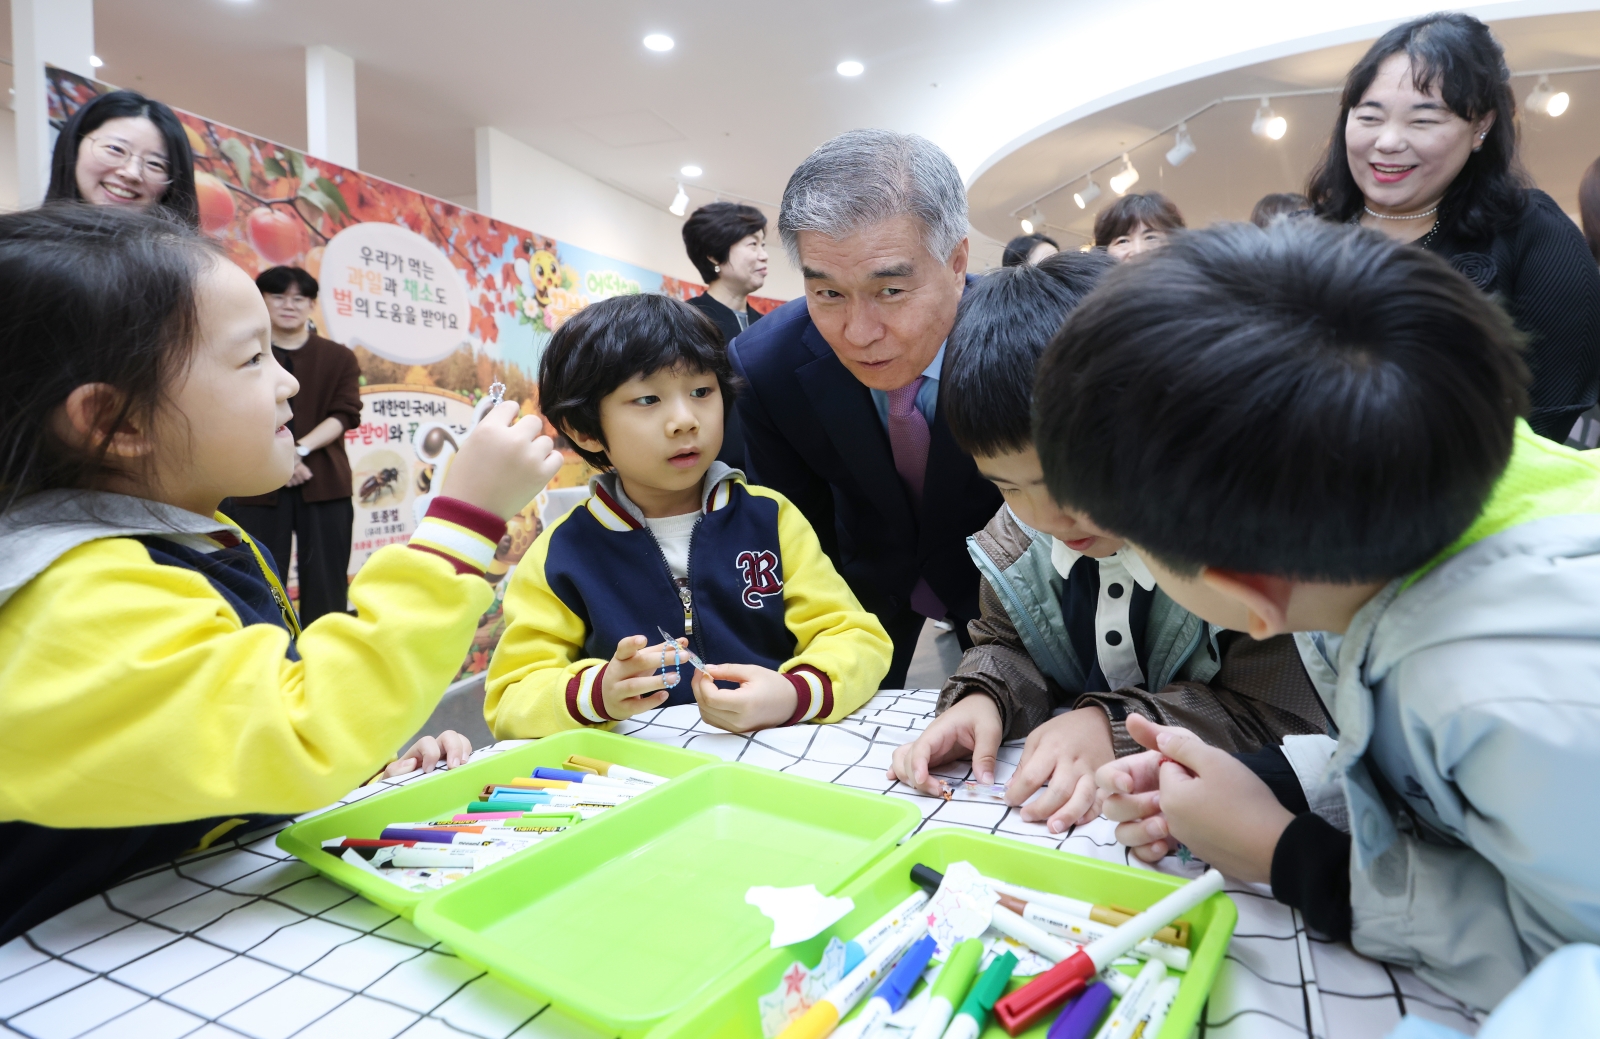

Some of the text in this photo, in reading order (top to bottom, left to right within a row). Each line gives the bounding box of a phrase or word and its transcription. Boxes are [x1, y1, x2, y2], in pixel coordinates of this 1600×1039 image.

[360, 246, 434, 281] 우리가 먹는
[347, 266, 447, 304] 과일과 채소도
[333, 288, 458, 329] 벌의 도움을 받아요
[373, 400, 446, 417] 대한민국에서
[371, 508, 399, 523] 토종벌
